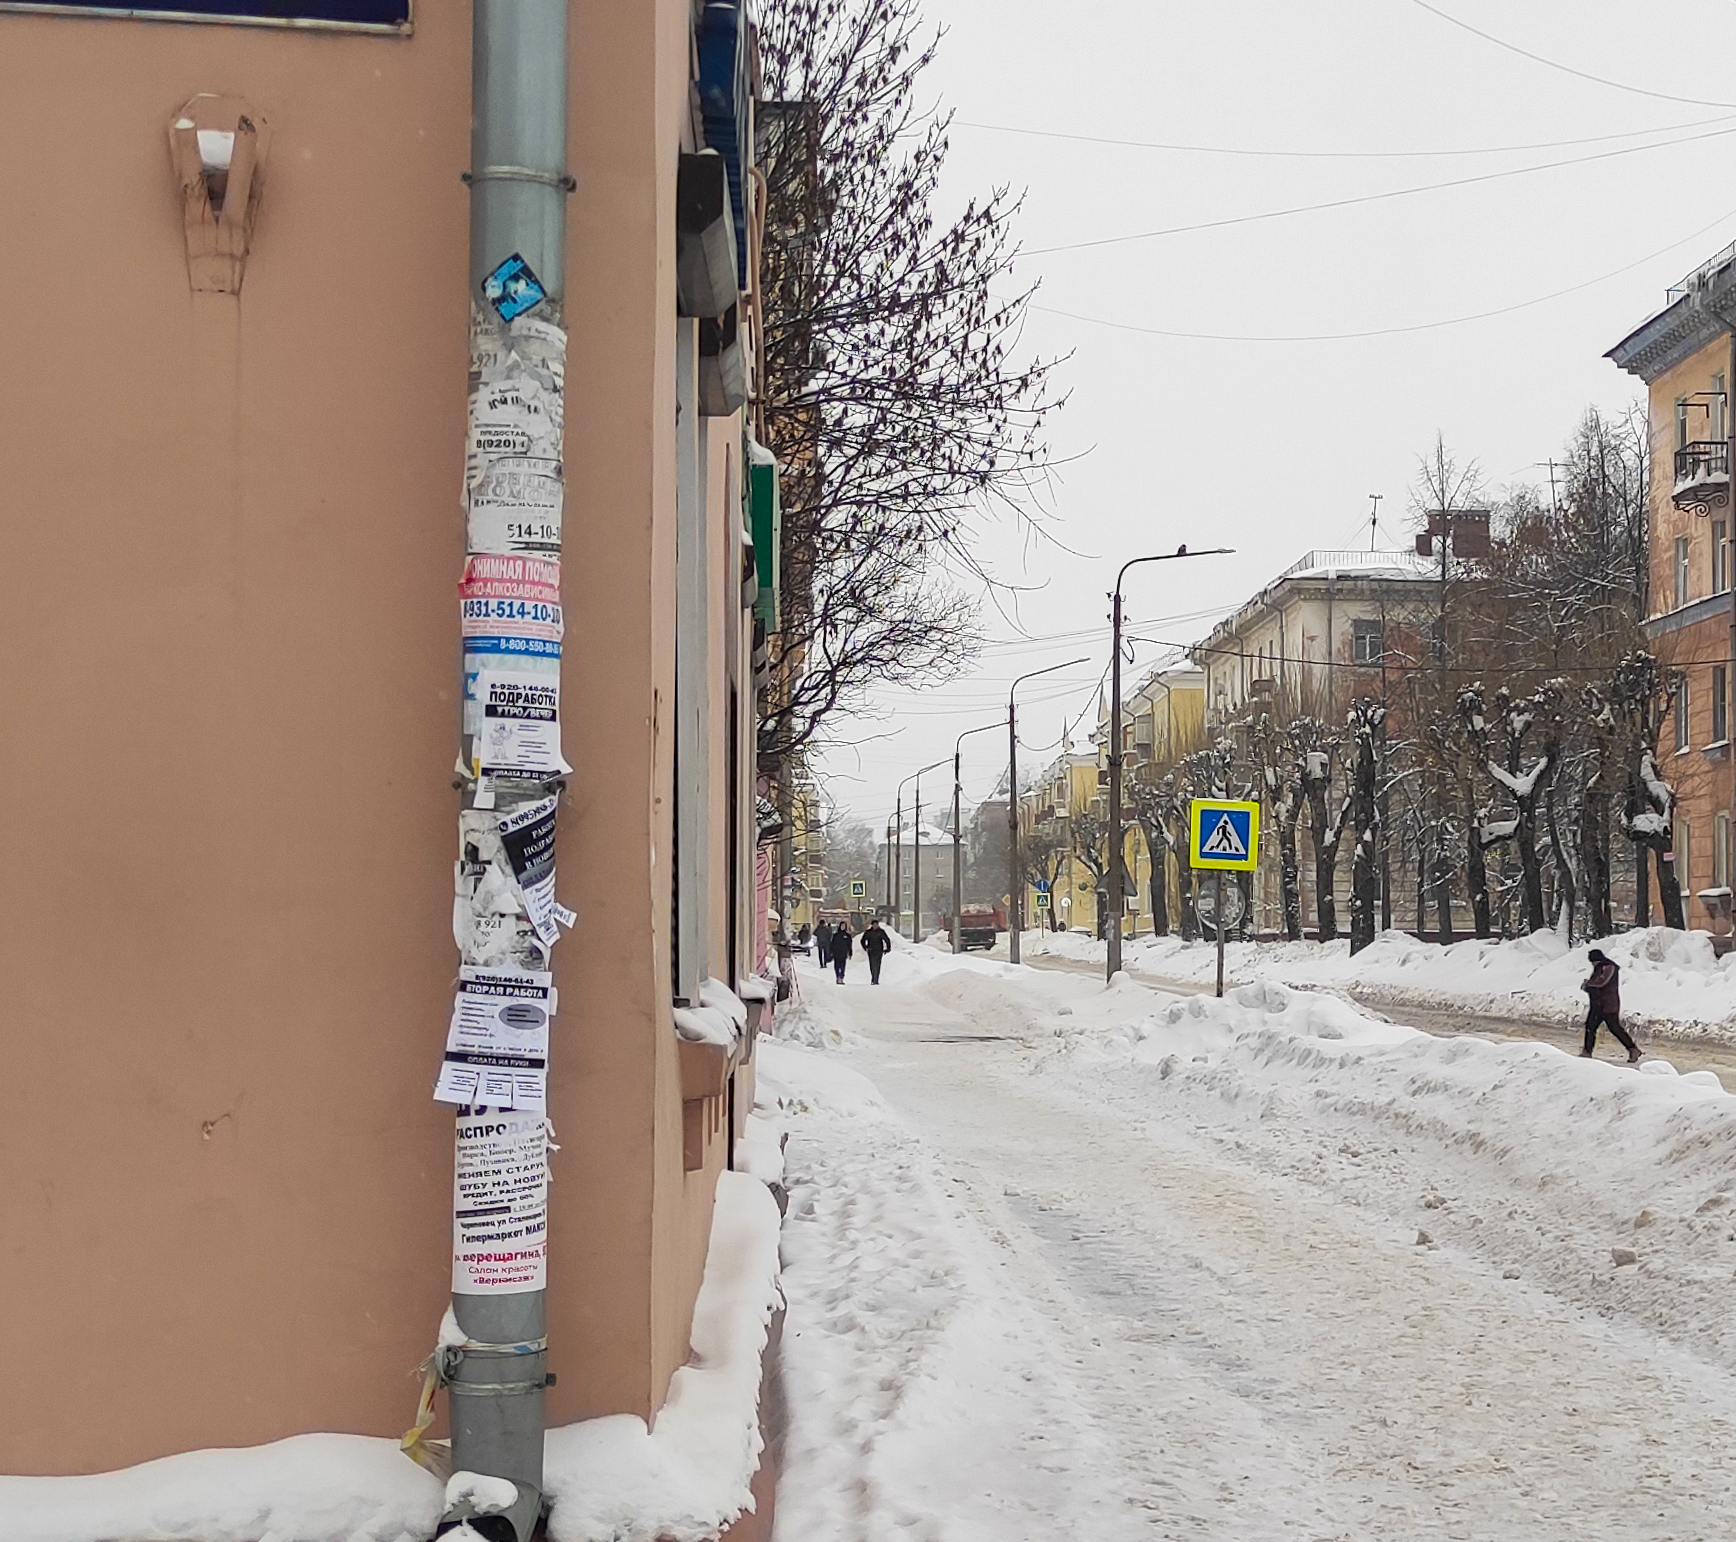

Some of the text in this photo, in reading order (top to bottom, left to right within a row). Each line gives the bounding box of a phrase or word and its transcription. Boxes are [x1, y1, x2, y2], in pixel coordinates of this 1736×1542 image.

[489, 690, 556, 706] ПОДРАБОТКА
[506, 986, 543, 998] РАБОТА
[461, 1229, 524, 1244] Гипермаркет
